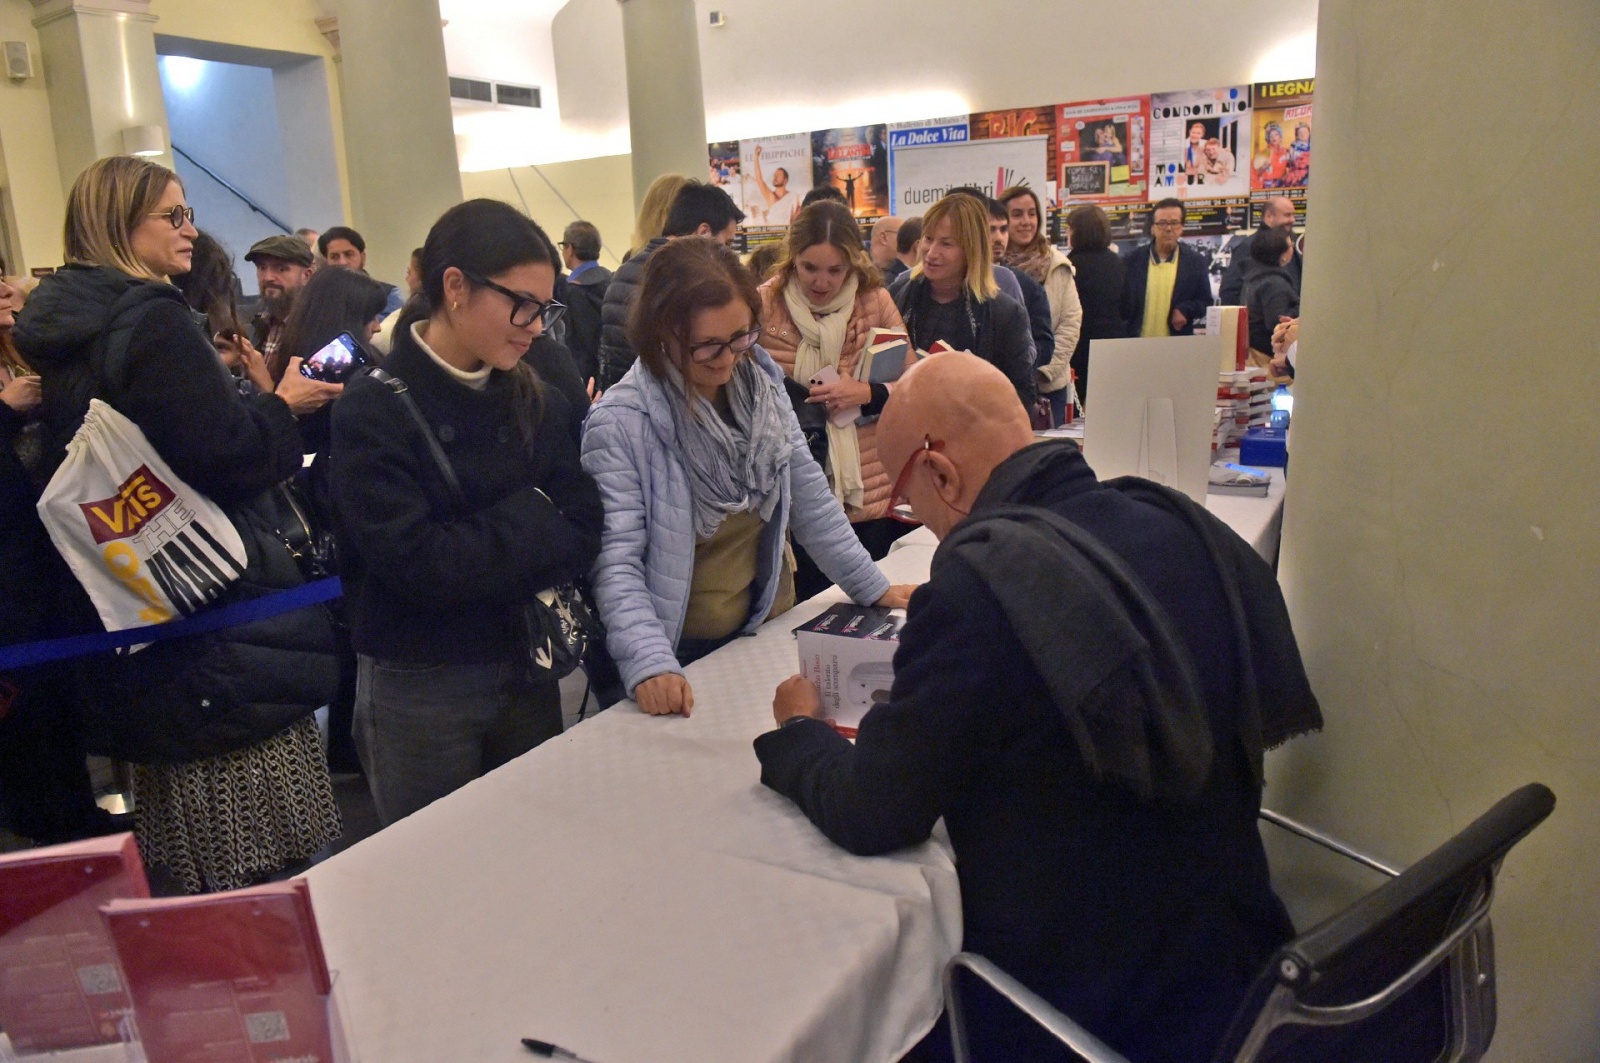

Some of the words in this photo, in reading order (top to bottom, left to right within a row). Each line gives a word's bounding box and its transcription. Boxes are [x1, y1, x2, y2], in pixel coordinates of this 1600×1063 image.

[1262, 85, 1267, 97] I
[891, 133, 906, 146] La
[908, 129, 939, 145] Dolce
[941, 127, 965, 141] Vita
[1156, 163, 1186, 175] MON
[1154, 173, 1205, 188] AMOUR
[904, 181, 993, 205] duemiri
[132, 498, 196, 555] THE
[145, 520, 247, 618] WALL
